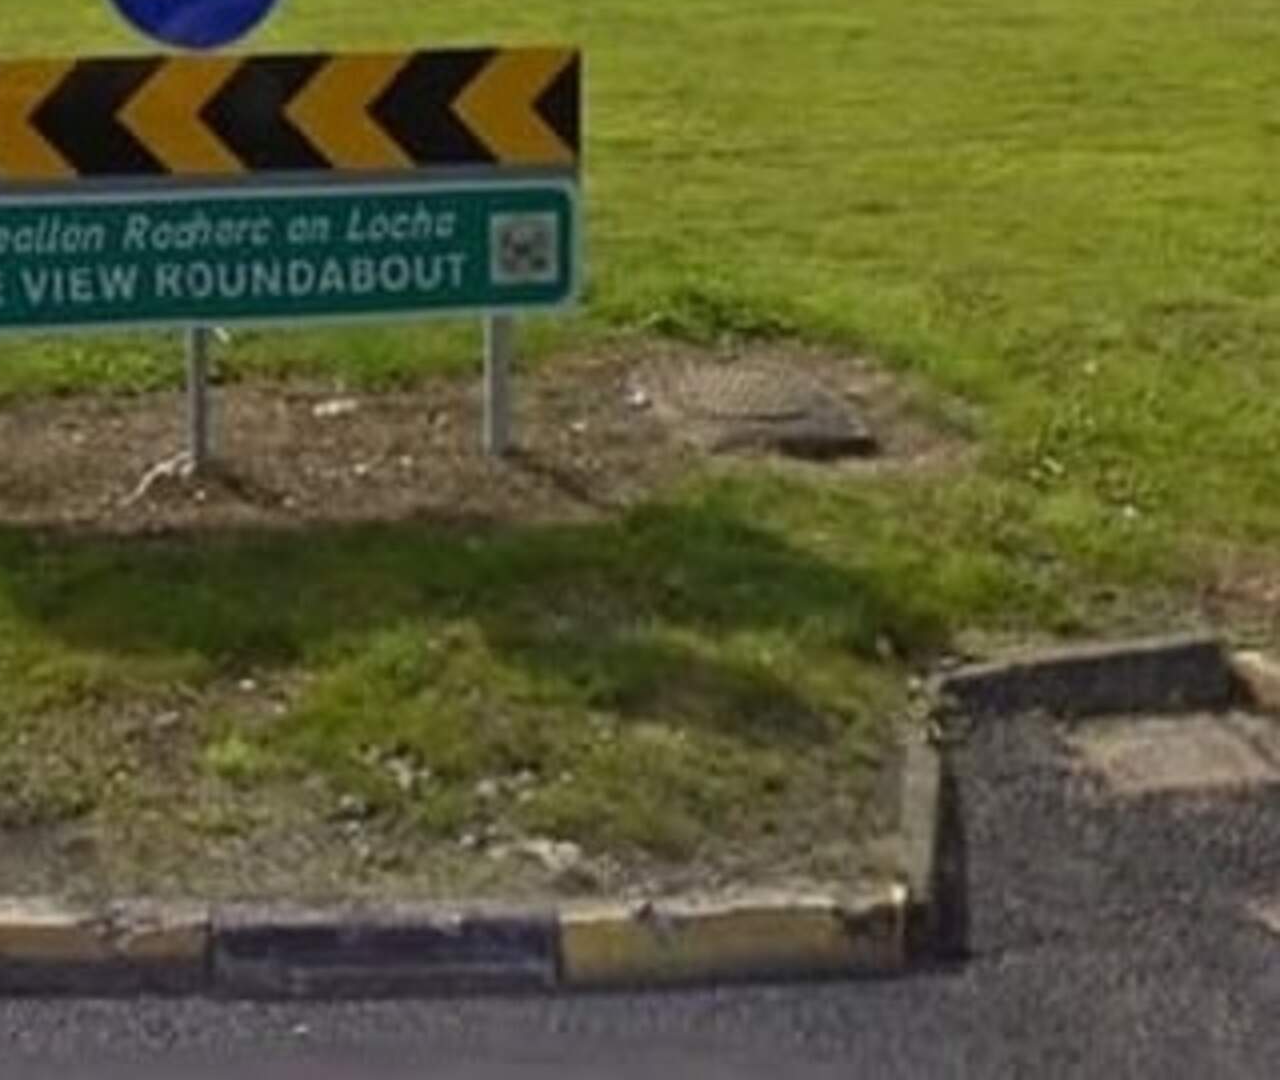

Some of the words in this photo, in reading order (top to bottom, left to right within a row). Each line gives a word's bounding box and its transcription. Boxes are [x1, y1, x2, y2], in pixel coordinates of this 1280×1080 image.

[286, 213, 331, 244] an
[346, 202, 457, 243] Locha
[20, 264, 139, 303] VIEW
[154, 252, 467, 298] ROUNDABOUT
